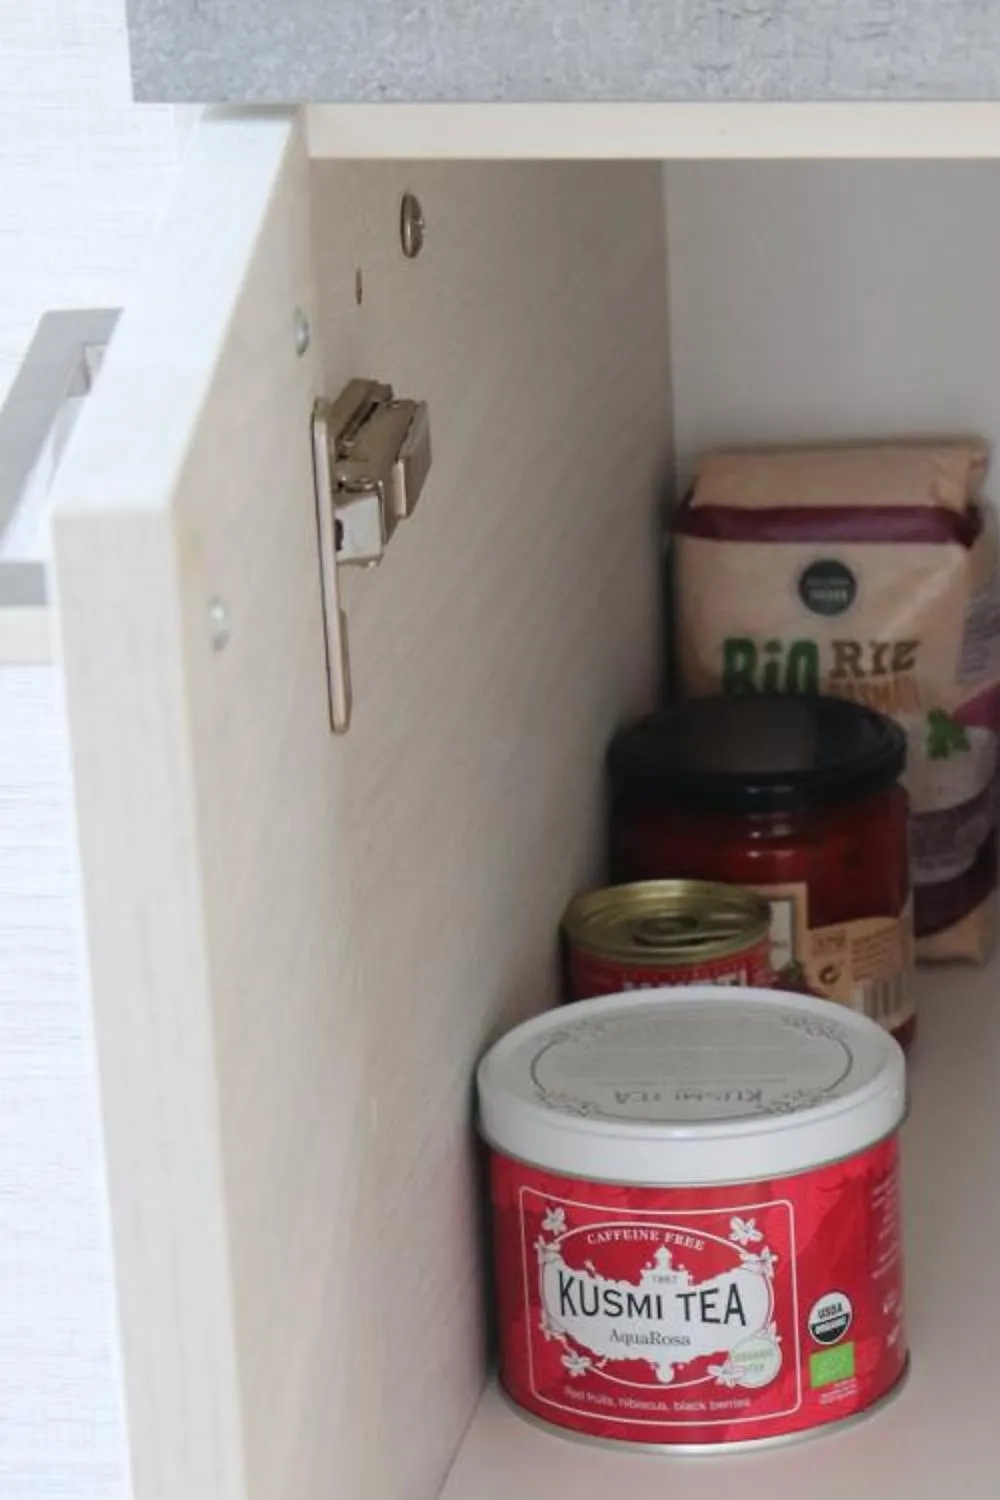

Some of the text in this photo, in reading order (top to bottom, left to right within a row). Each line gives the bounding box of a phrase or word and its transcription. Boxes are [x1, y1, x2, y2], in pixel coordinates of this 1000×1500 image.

[830, 638, 921, 679] RIZ
[587, 1228, 705, 1251] CAFFEINE FREE
[558, 1270, 747, 1326] KUSMI TEA
[609, 1328, 692, 1347] AquaRosa
